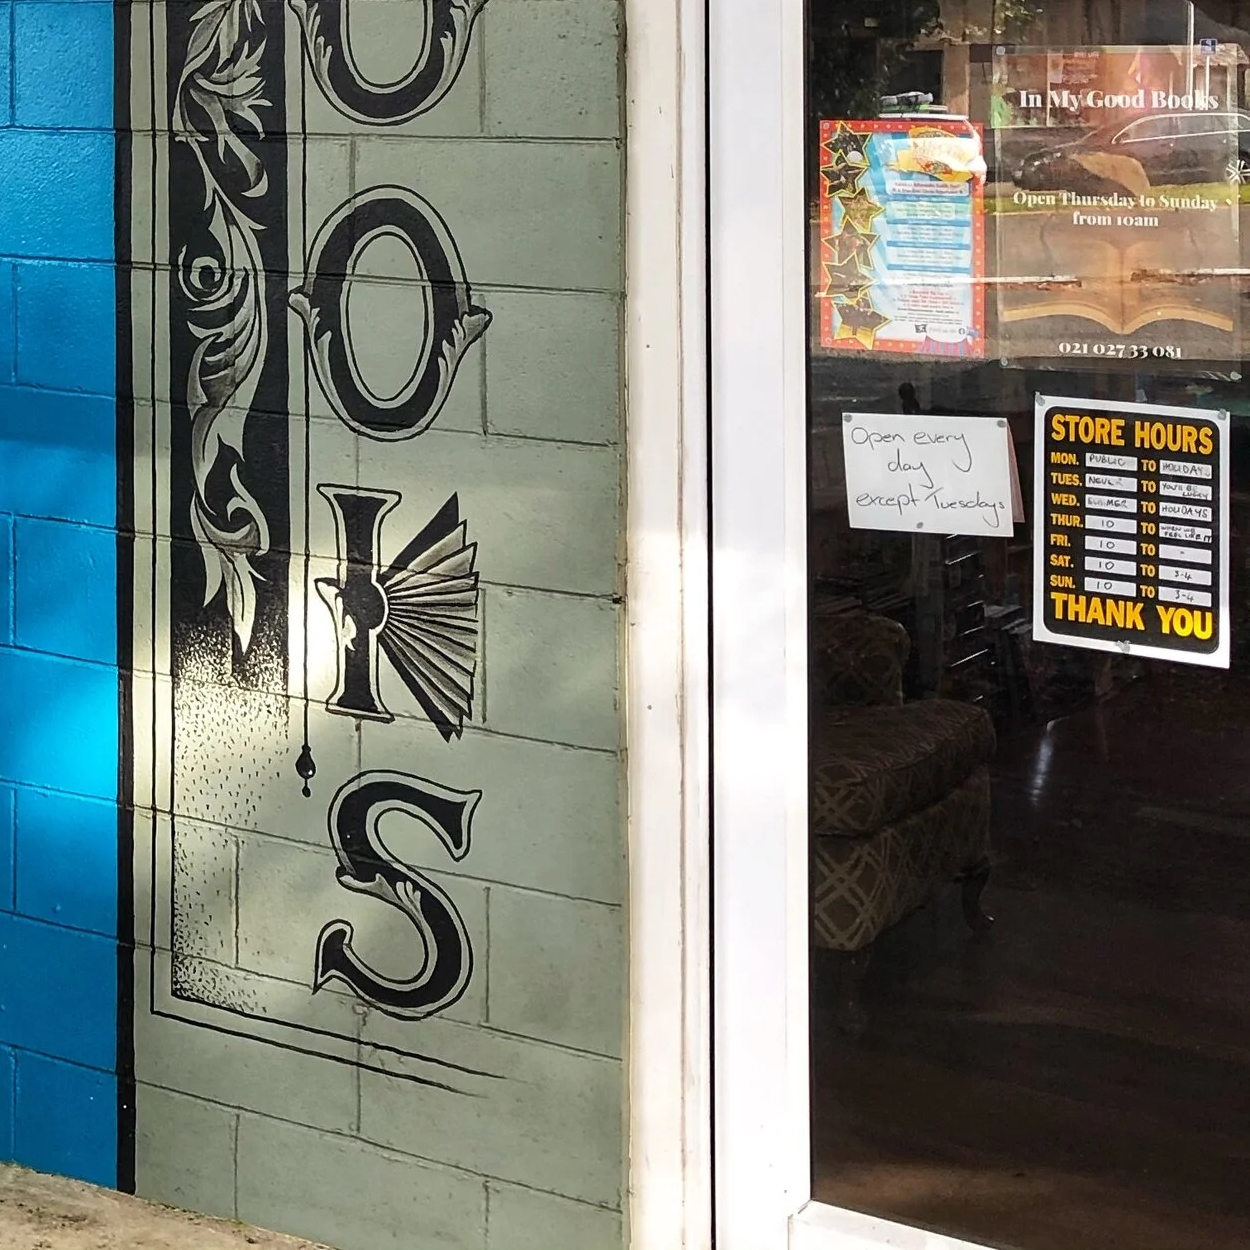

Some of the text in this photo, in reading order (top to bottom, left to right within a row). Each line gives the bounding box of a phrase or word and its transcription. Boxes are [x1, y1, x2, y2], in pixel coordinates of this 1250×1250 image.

[1019, 89, 1219, 112] In My Good Books
[1013, 191, 1217, 213] Open Thursday to Sunday
[1072, 211, 1159, 227] from 10am
[1058, 342, 1182, 359] 021 027 33 081
[1051, 413, 1214, 456] STORE HOURS
[851, 427, 973, 473] Open every
[1050, 451, 1080, 466] MON.
[1141, 459, 1157, 472] TO
[887, 448, 934, 489] day
[1050, 472, 1083, 486] TUES.
[1141, 480, 1157, 493] TO
[856, 483, 1006, 529] except Tuesdays
[1051, 493, 1080, 507] WED.
[1141, 501, 1157, 514] TO
[1050, 513, 1084, 528] THUR.
[1101, 519, 1114, 528] 10
[1140, 522, 1156, 535] TO
[1050, 533, 1156, 556] FRI. 10 TO
[1050, 554, 1074, 568] SAT.
[1098, 561, 1115, 570] 10
[1140, 564, 1156, 577] TO
[1050, 574, 1076, 588] SUN.
[1097, 581, 1113, 590] 10
[1139, 584, 1156, 599] TO
[1050, 591, 1213, 640] THANK YOU
